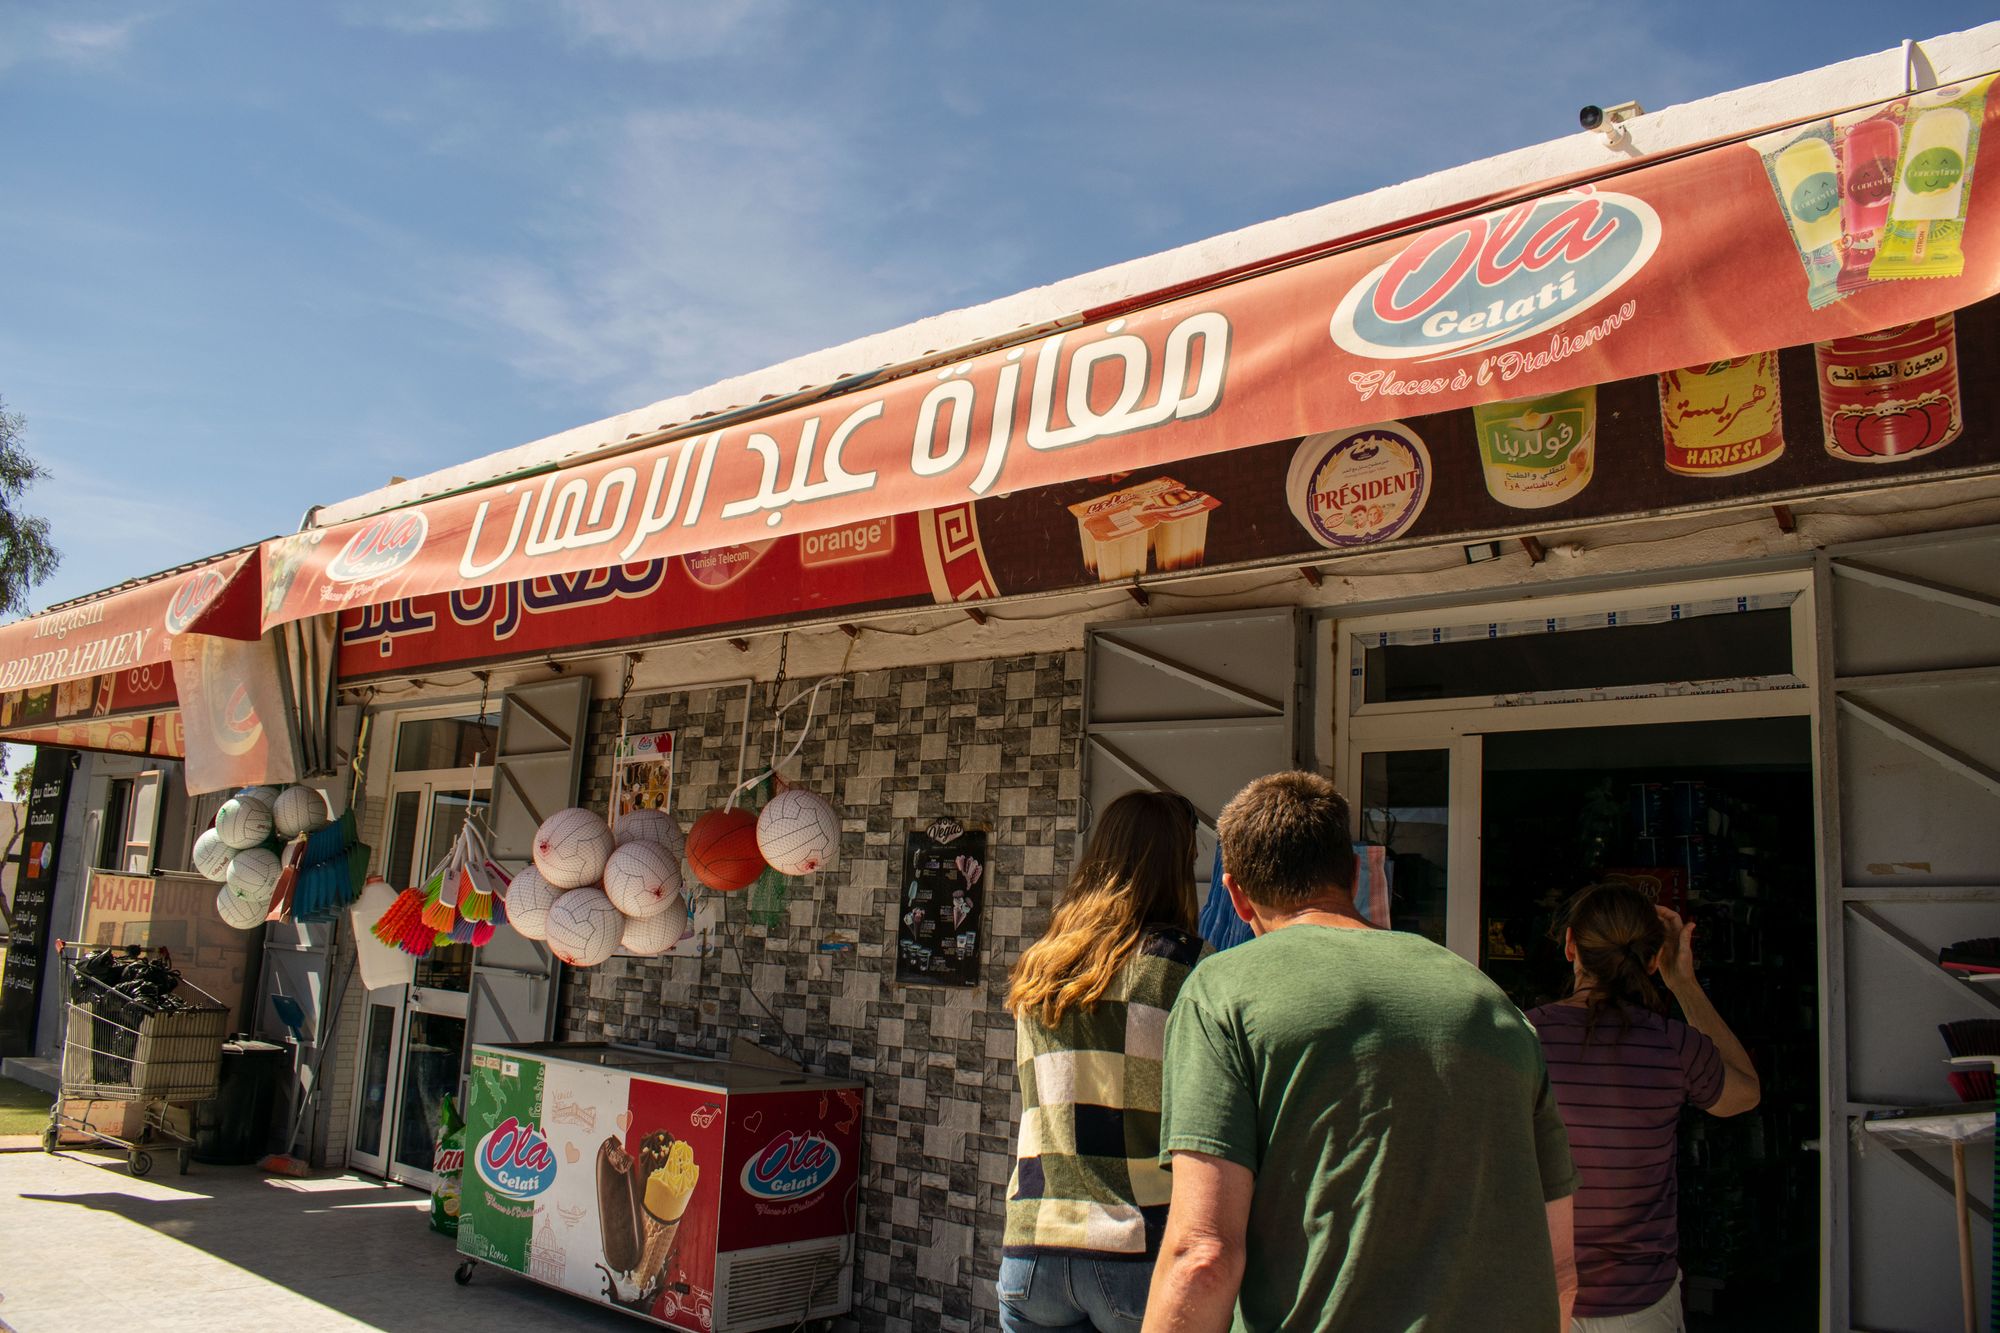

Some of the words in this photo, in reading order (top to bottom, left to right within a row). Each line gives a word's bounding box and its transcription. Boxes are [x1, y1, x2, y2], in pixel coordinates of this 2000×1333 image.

[1915, 230, 1926, 255] CITRON
[1422, 270, 1579, 339] Gelati
[1348, 368, 1450, 402] Glaces
[1450, 368, 1473, 391] à
[1477, 299, 1637, 388] l'Italienne
[909, 311, 1233, 497] مغازة
[1677, 384, 1767, 437] هريسة
[719, 399, 887, 528] عبد
[1686, 438, 1762, 465] HARISSA
[457, 429, 725, 581] الرحمان
[1312, 469, 1419, 513] PRÉSIDENT
[806, 523, 882, 555] orange
[691, 553, 717, 570] Tunisie
[718, 550, 750, 565] Telecom
[33, 602, 105, 640] Magasin
[929, 823, 963, 843] Vegas
[433, 1141, 464, 1172] Can
[486, 1116, 553, 1172] Olà
[755, 1130, 831, 1183] Olà
[497, 1170, 540, 1191] Gelati
[770, 1171, 819, 1192] Gelati
[489, 1243, 509, 1263] Rome
